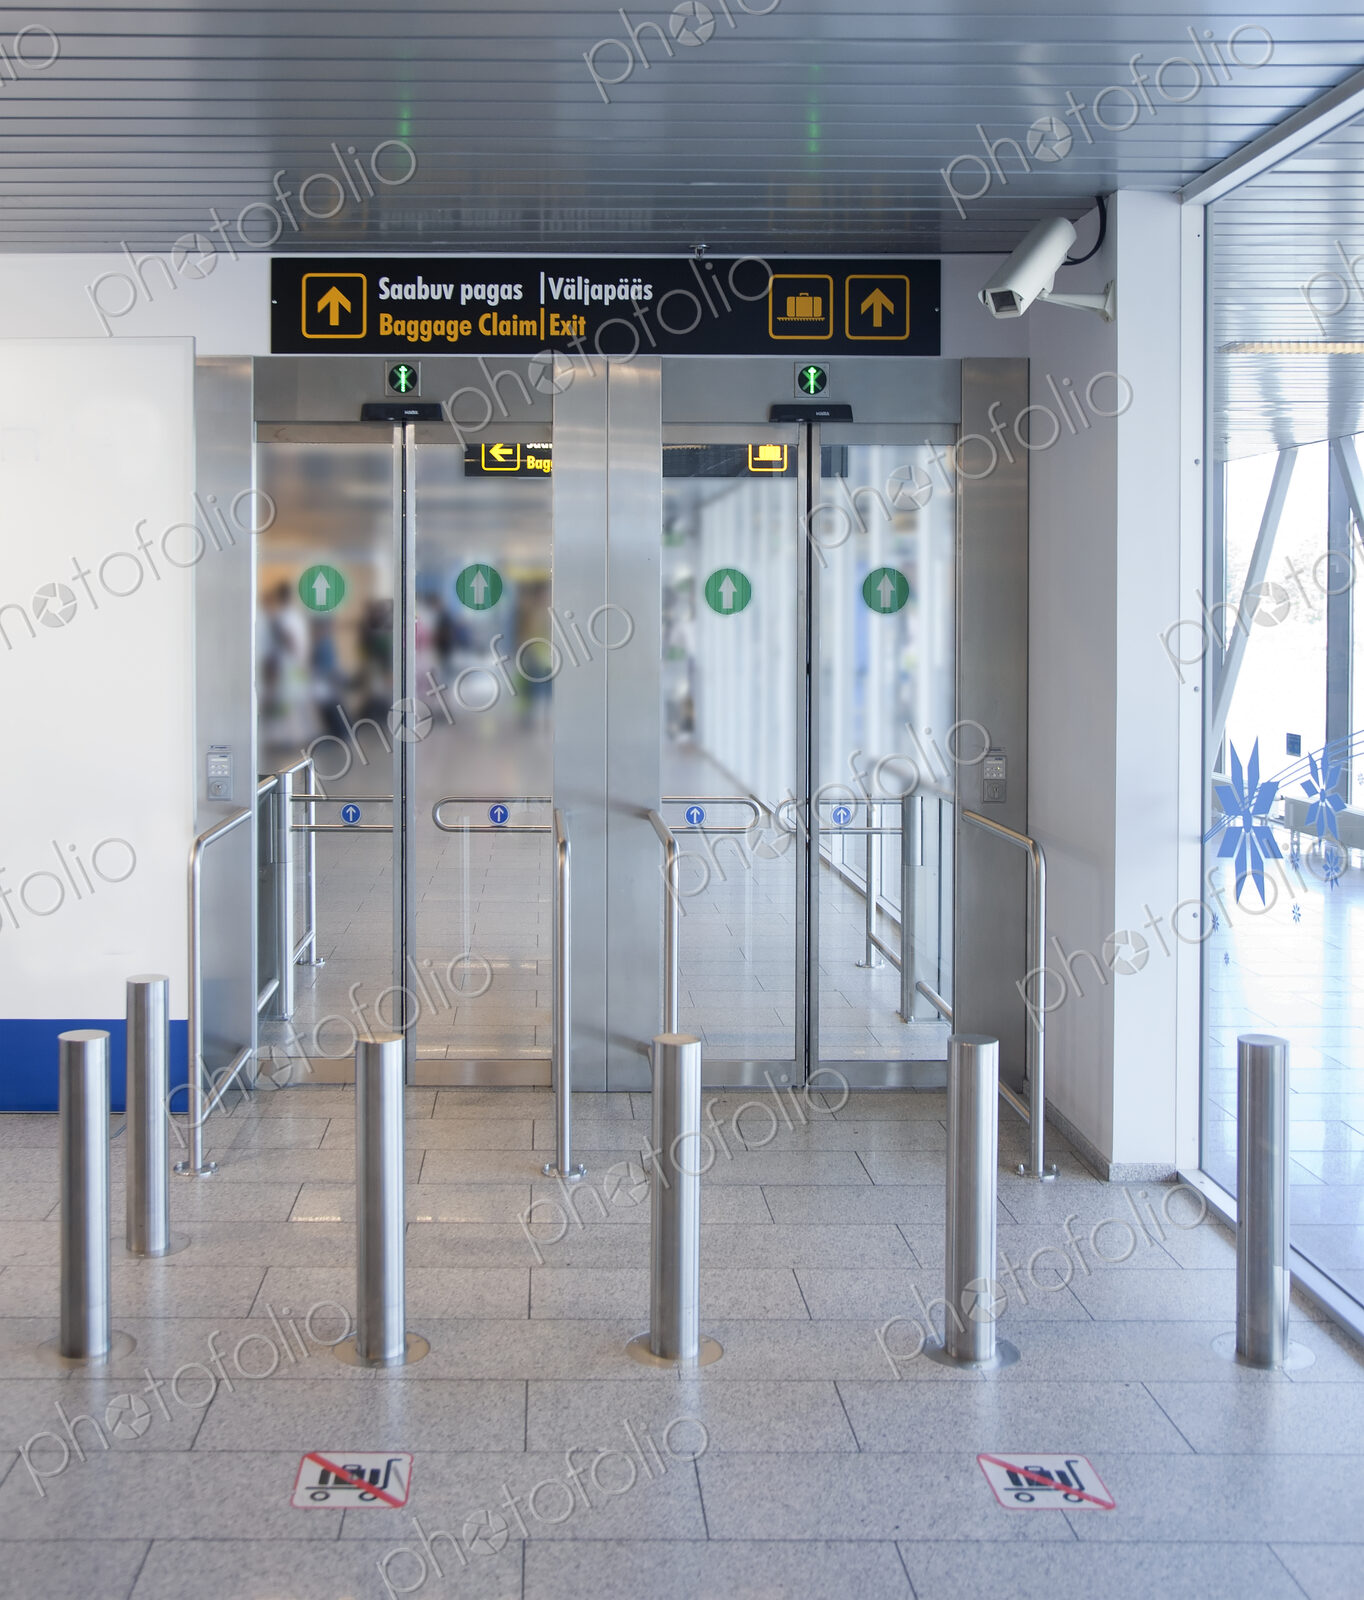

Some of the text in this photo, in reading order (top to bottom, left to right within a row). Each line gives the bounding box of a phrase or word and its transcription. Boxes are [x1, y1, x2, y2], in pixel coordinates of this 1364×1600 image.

[379, 276, 523, 306] Saabuv pagas
[548, 276, 653, 306] Väljapääs
[379, 312, 537, 342] Baggage Claim
[550, 313, 586, 336] Exit
[526, 455, 552, 473] Bag
